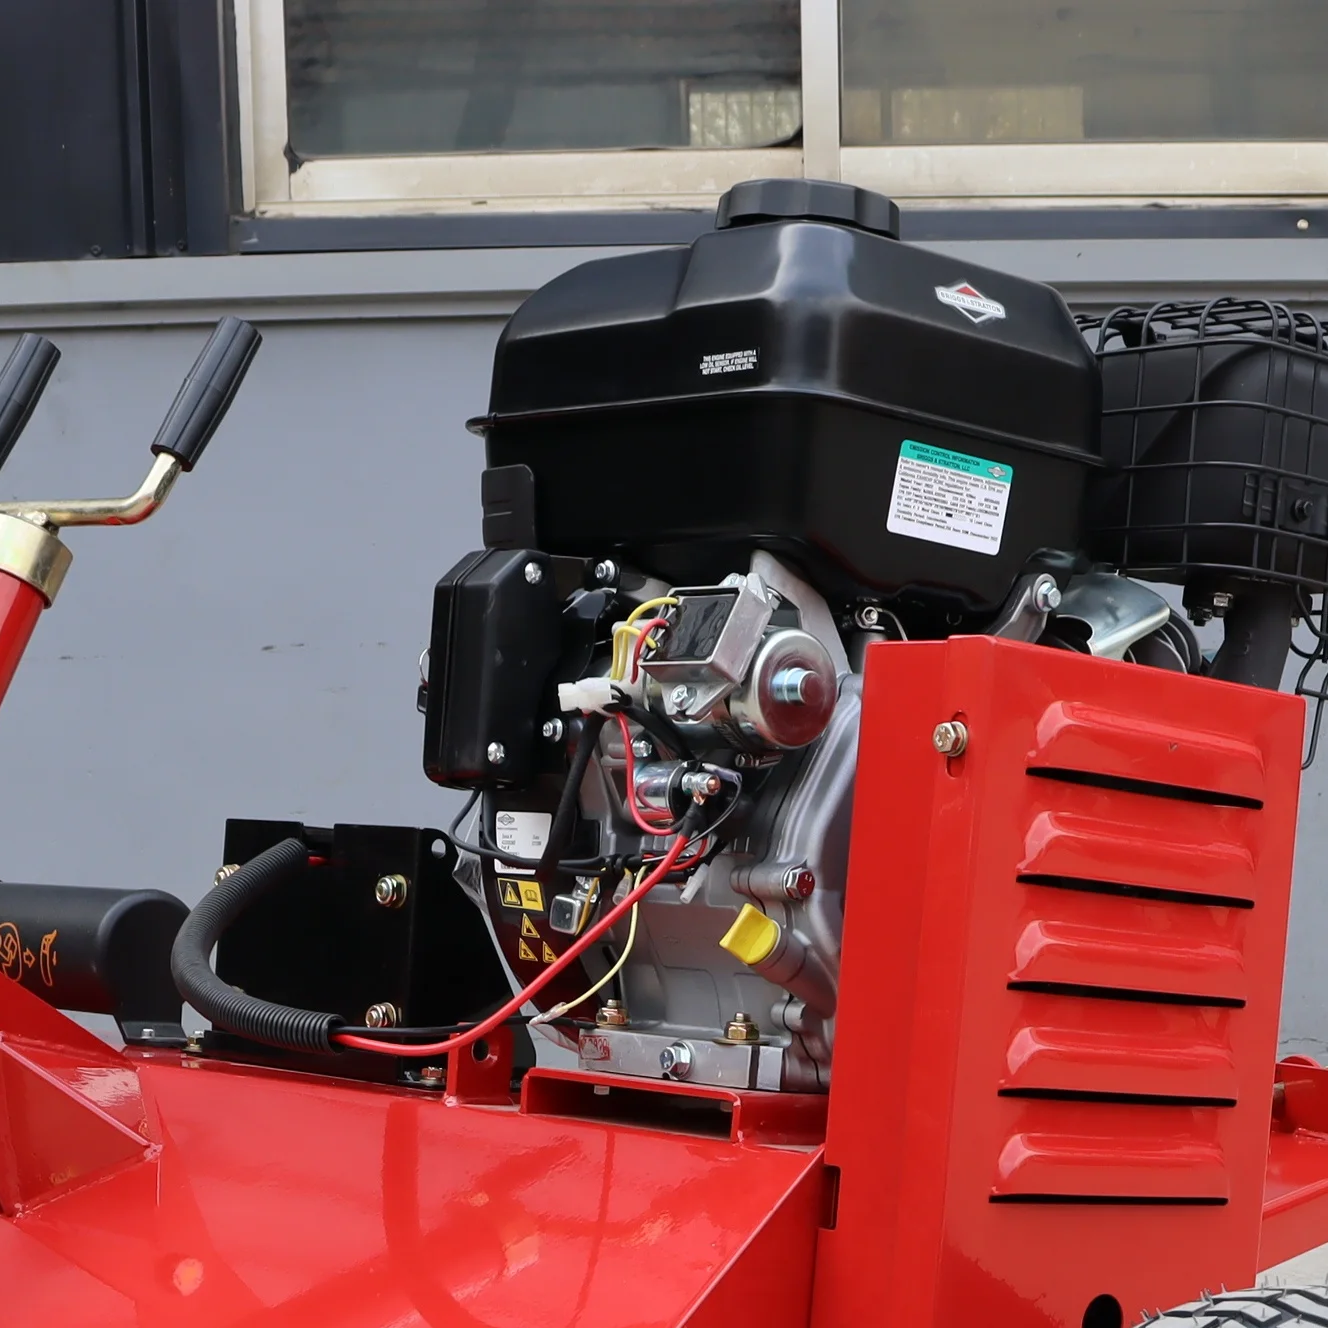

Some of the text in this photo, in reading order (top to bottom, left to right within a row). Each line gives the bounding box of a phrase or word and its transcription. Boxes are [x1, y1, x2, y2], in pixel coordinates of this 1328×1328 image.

[940, 291, 966, 304] BRIGGS
[970, 299, 1001, 313] STRATTON
[930, 450, 951, 459] CONTROL
